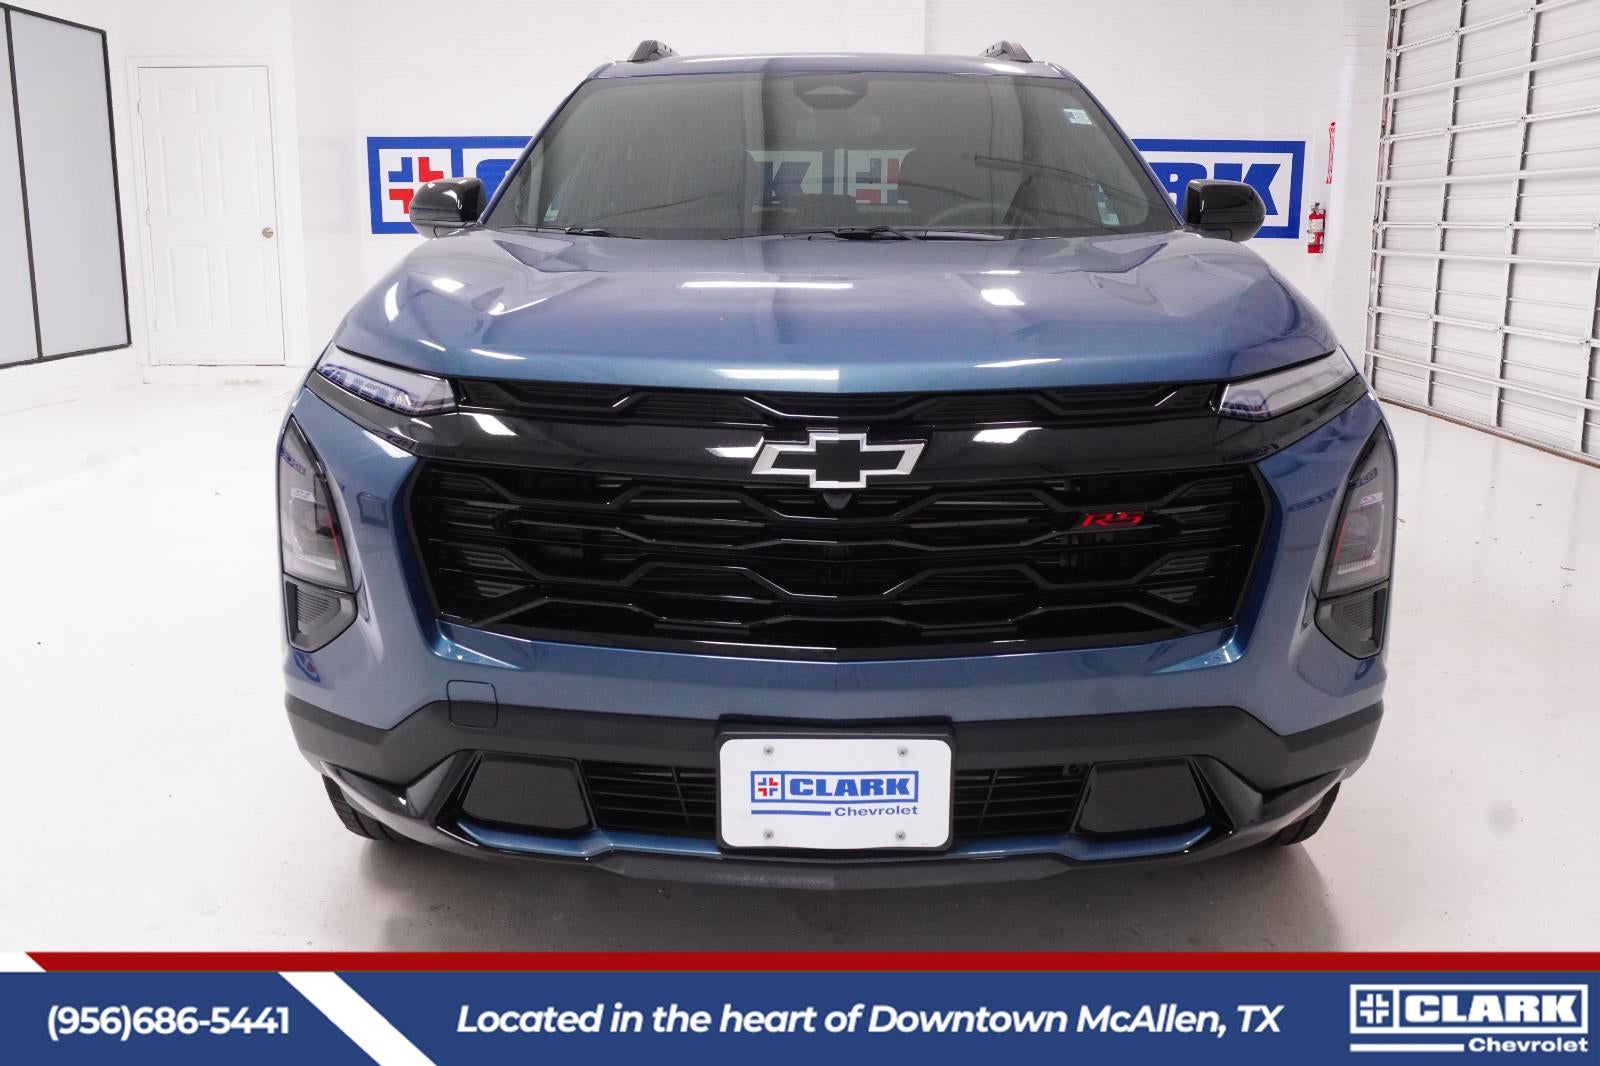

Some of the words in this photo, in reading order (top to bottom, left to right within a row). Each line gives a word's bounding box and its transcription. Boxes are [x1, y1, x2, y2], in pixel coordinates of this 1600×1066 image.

[1080, 511, 1143, 528] RS
[789, 778, 911, 797] CLARK
[834, 804, 919, 817] Chevrolet
